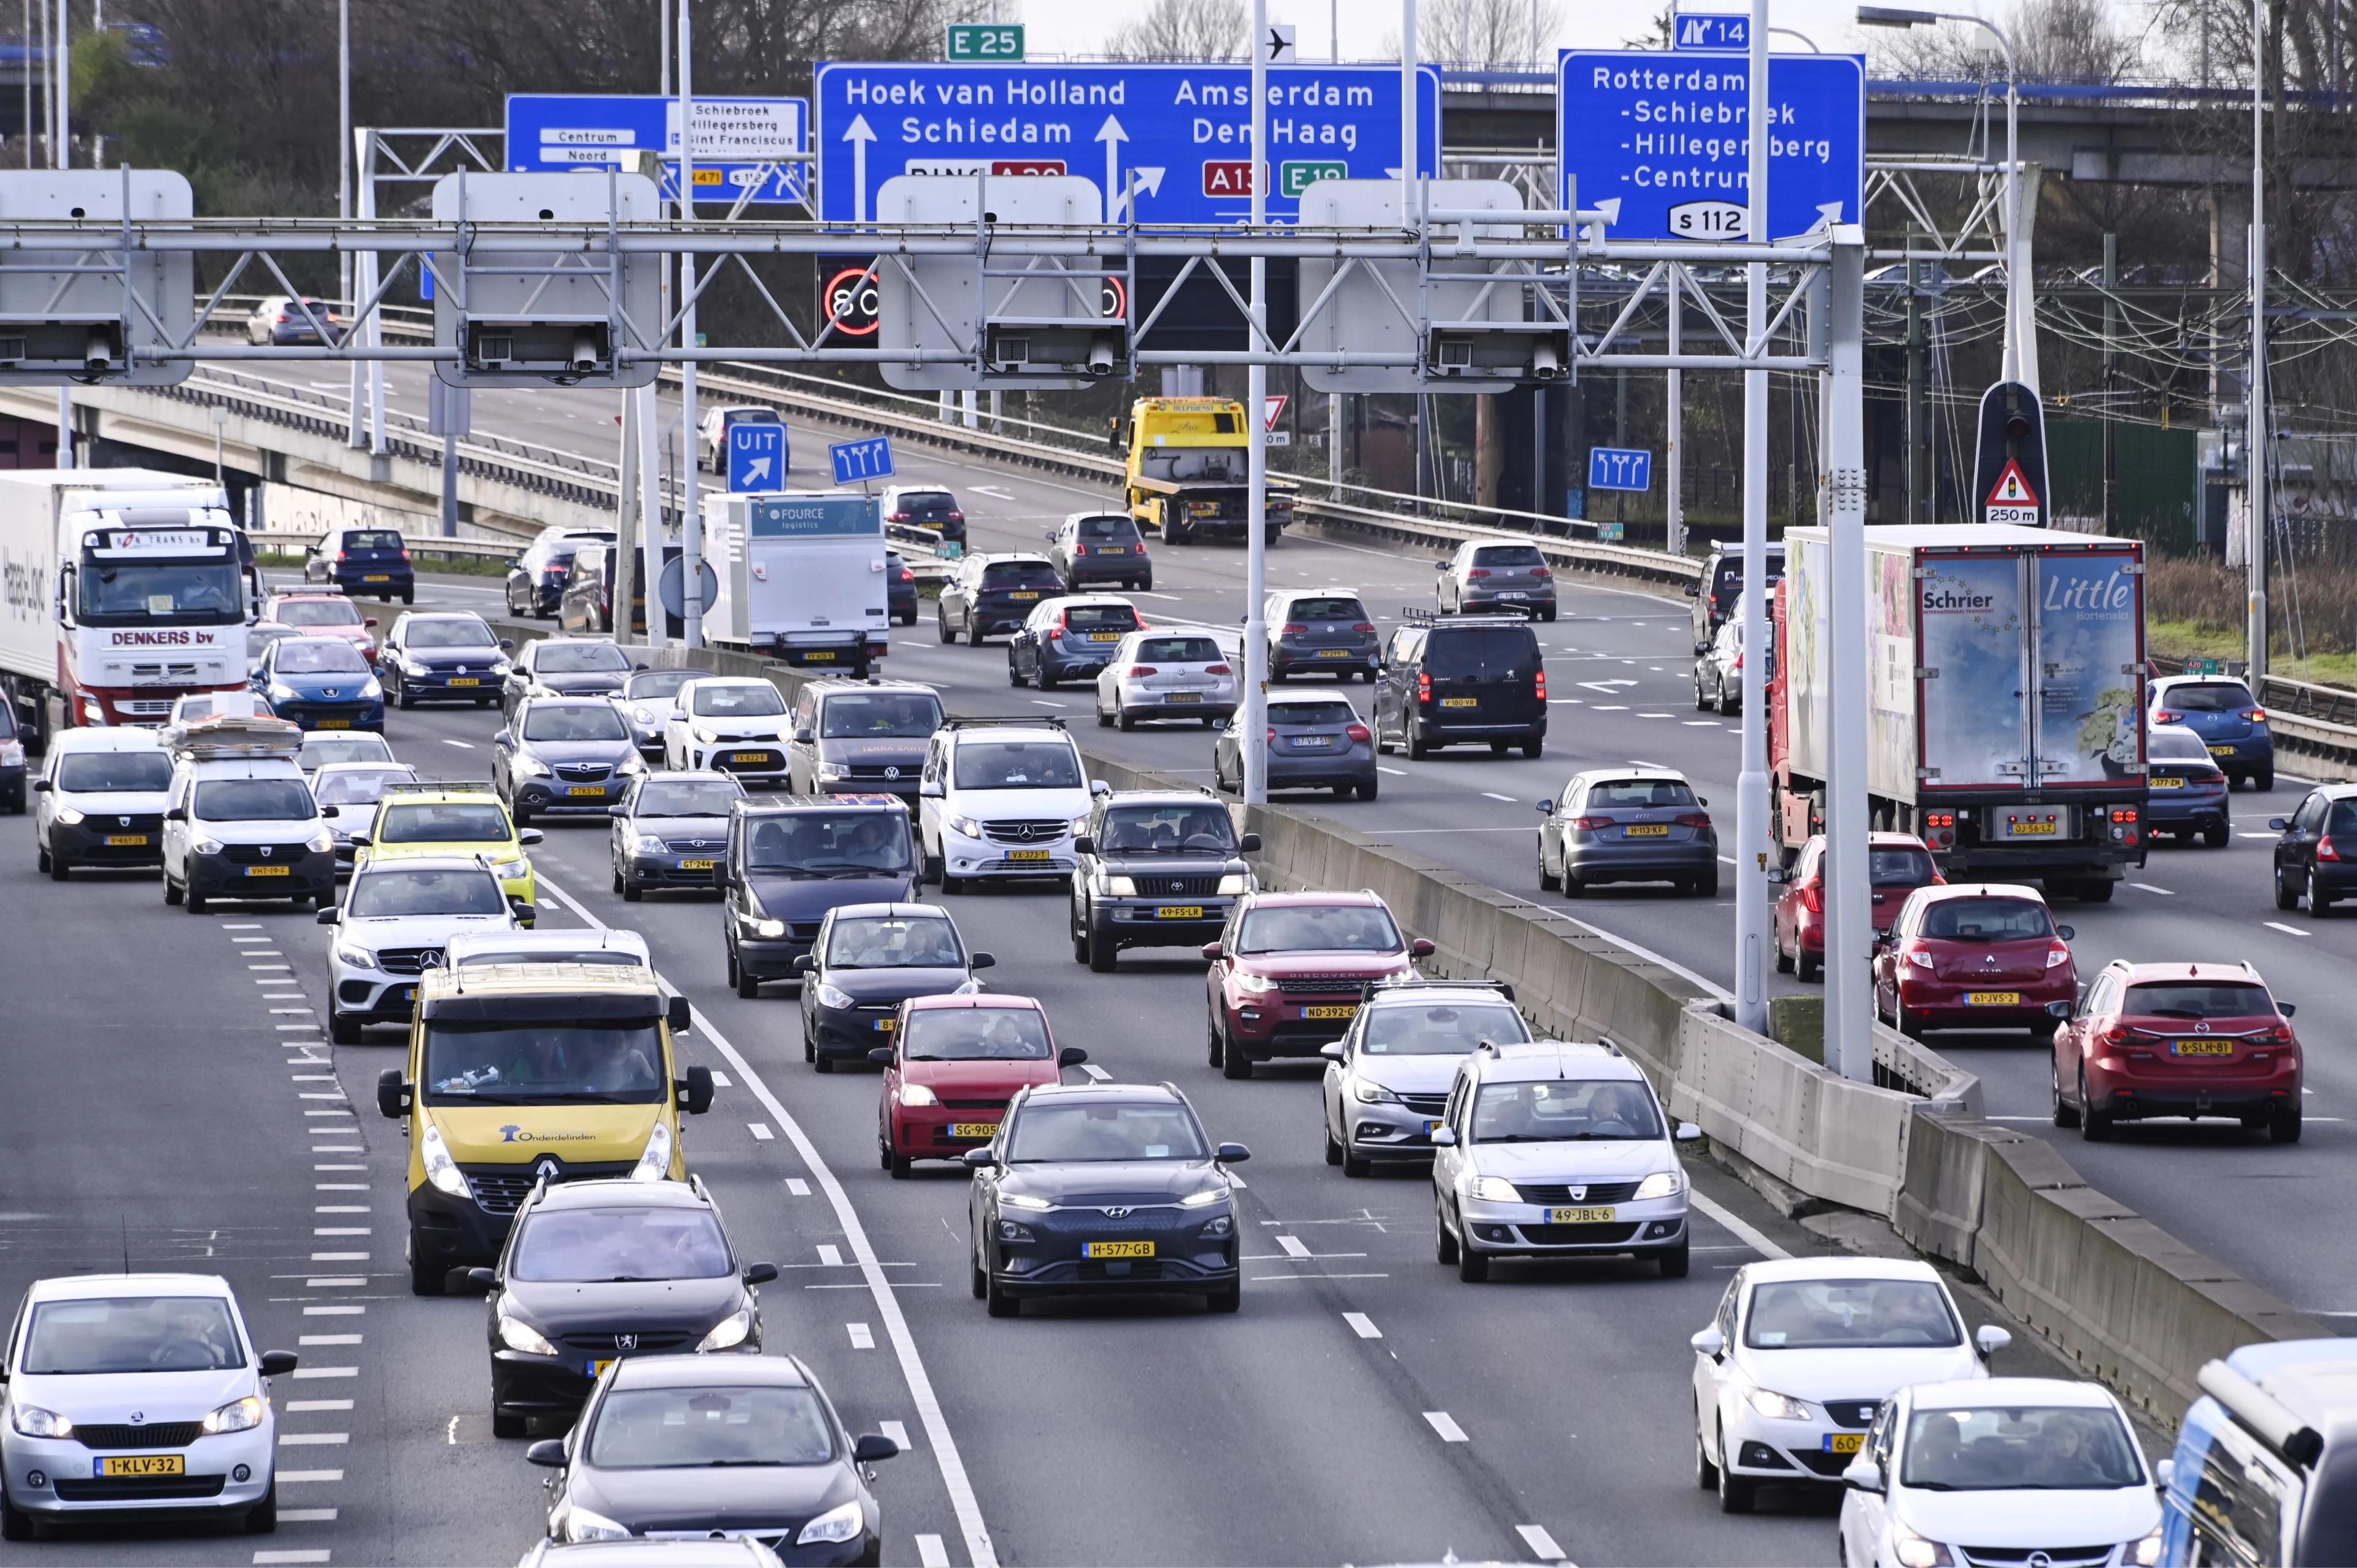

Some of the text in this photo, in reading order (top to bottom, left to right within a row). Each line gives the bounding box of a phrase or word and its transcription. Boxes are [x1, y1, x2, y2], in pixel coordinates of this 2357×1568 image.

[1719, 23, 1744, 43] 14
[955, 32, 1016, 53] E 25
[1594, 68, 1744, 91] Rotterdam
[847, 80, 1124, 104] Hoek van Holland
[1175, 80, 1372, 106] Amserdam
[697, 106, 769, 115] Schiebroek
[1622, 101, 1795, 125] -Schiebrek
[559, 133, 617, 142] Centrum
[902, 117, 1070, 142] Schiedam
[1194, 118, 1357, 151] Den Haag
[720, 136, 793, 144] Franciscus
[1622, 133, 1830, 163] -Hillegerberg
[569, 151, 606, 160] Noord
[699, 173, 720, 182] 471
[1292, 169, 1306, 189] E
[1679, 211, 1741, 231] s 112
[834, 289, 878, 316] 80
[738, 433, 776, 450] UIT
[782, 508, 824, 519] FOURCE
[1991, 509, 2035, 521] 250 m
[1924, 590, 1993, 608] Schrier
[2044, 571, 2129, 611] Little
[2077, 611, 2128, 620] Hortensia
[112, 631, 214, 645] DENKERS bv
[1309, 1007, 1354, 1016] ND-392-G
[2181, 1042, 2227, 1052] 6-SLH-81
[519, 1132, 596, 1141] Onderdelinden
[1555, 1209, 1609, 1221] 49-JBL-6
[1093, 1243, 1150, 1255] H-577-GB
[111, 1458, 175, 1473] 1-KLV-32
